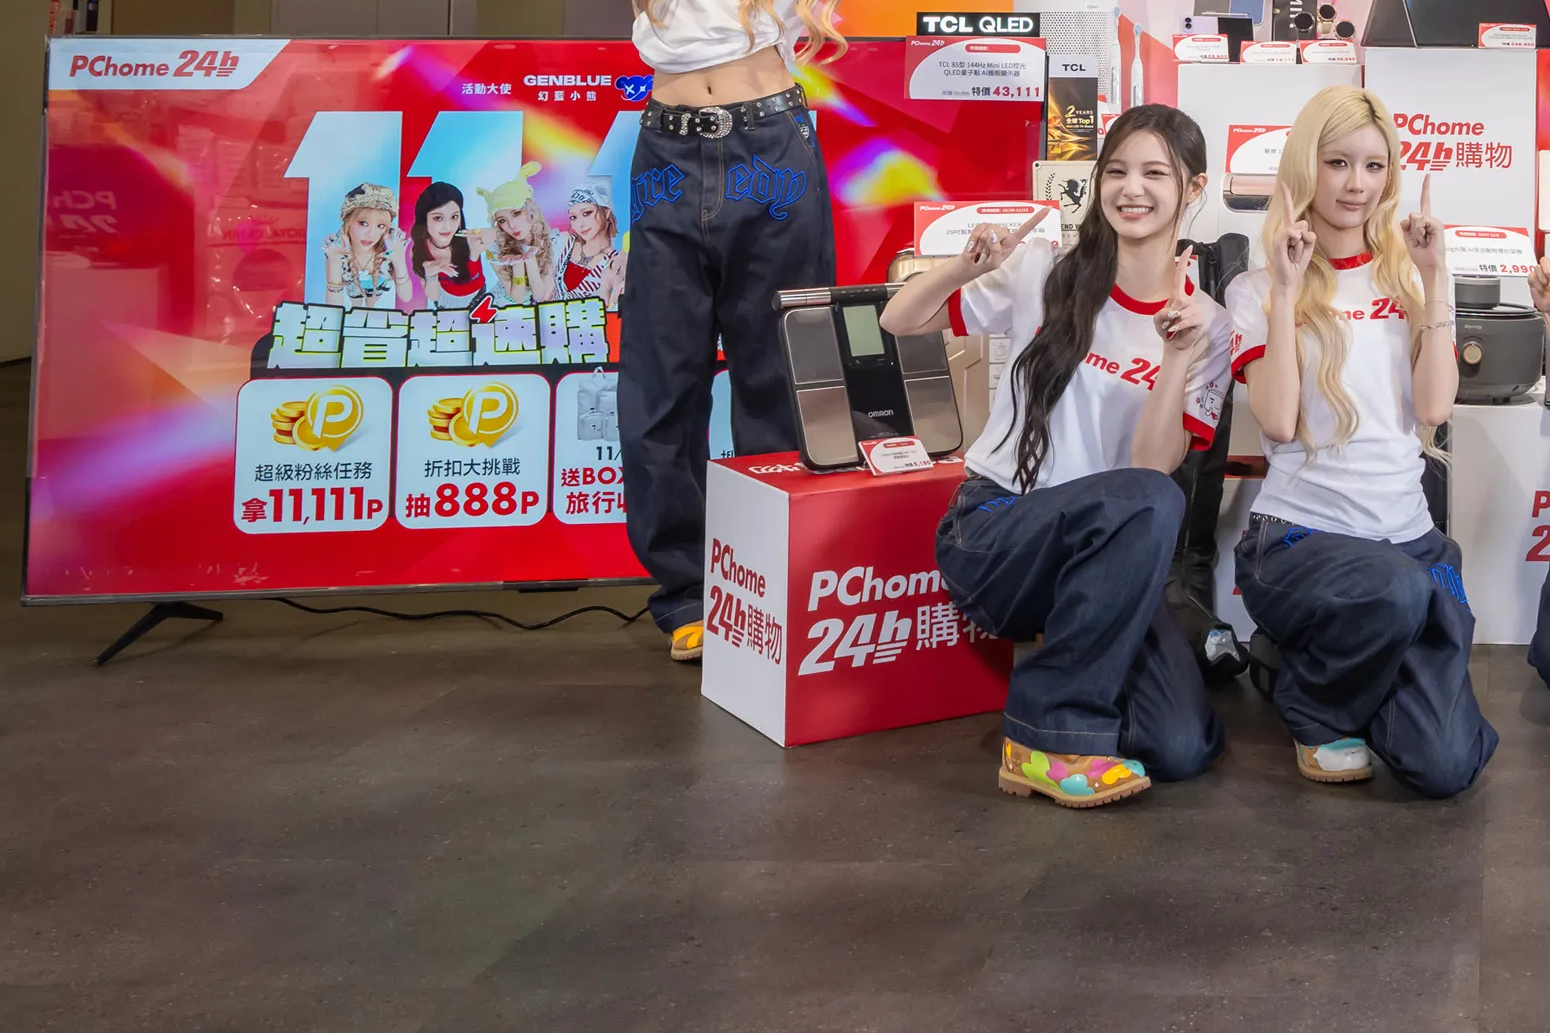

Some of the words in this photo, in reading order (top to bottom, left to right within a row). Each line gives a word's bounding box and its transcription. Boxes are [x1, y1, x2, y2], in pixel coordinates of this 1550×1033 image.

[923, 16, 973, 33] TCL
[979, 16, 1033, 33] QLED
[69, 55, 169, 78] PChome
[172, 50, 240, 78] 24h
[462, 83, 512, 95] 活動大使
[523, 75, 612, 87] GENBLUE
[537, 91, 597, 101] 幻藍小熊
[971, 86, 991, 97] 特價
[993, 86, 1040, 98] 43,111
[1393, 113, 1485, 136] PChome
[1479, 263, 1498, 273] 特價
[1500, 263, 1536, 274] 2,990
[267, 297, 609, 370] 超省超速購
[868, 409, 894, 417] OMRON
[254, 461, 373, 482] 超級粉絲任務
[424, 458, 521, 477] 折扣大挑戰
[710, 537, 766, 599] PChome
